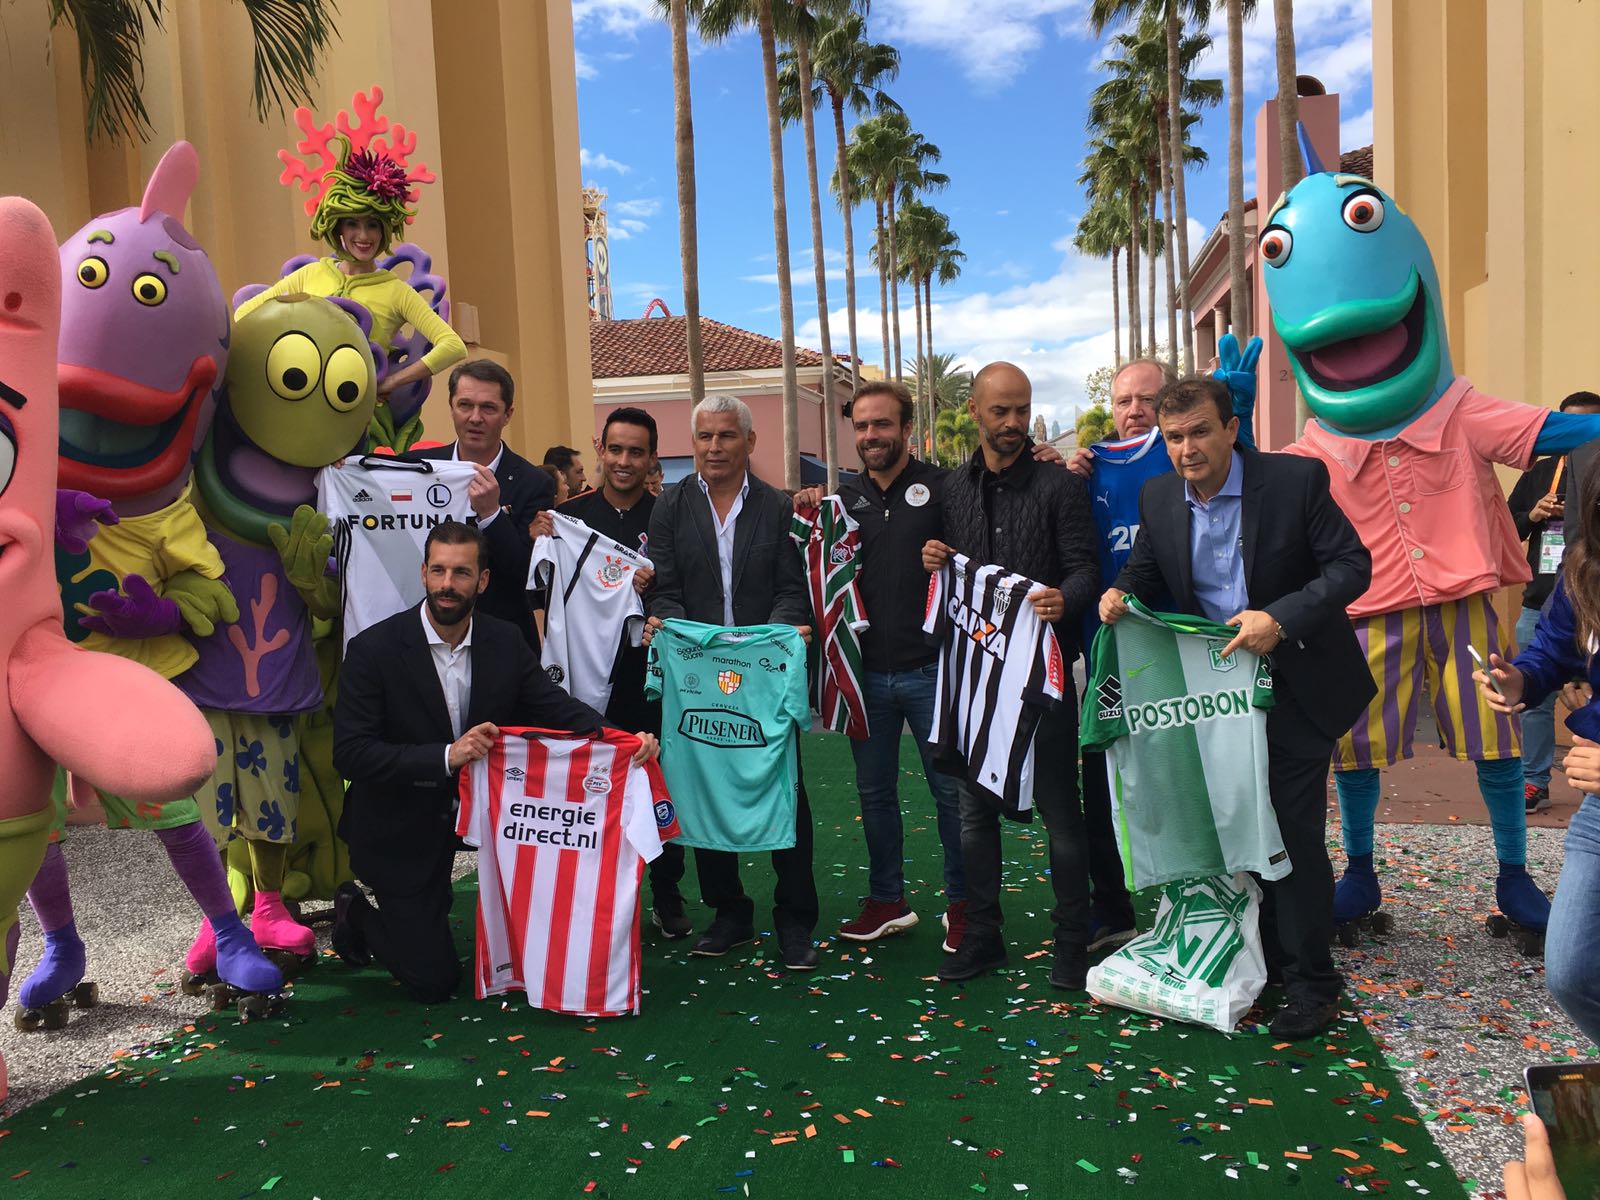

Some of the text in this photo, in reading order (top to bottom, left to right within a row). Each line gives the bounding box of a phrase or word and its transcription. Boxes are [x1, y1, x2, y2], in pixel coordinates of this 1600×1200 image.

[433, 487, 445, 504] L
[948, 596, 1007, 662] CAIXA
[712, 656, 752, 668] marathon
[1258, 679, 1272, 688] SU
[1099, 709, 1122, 719] SUZU
[1126, 689, 1251, 732] POSTOBON
[688, 714, 758, 742] PILSENER
[510, 803, 596, 827] energie
[503, 822, 597, 849] direct.nl
[1159, 972, 1187, 991] Verde
